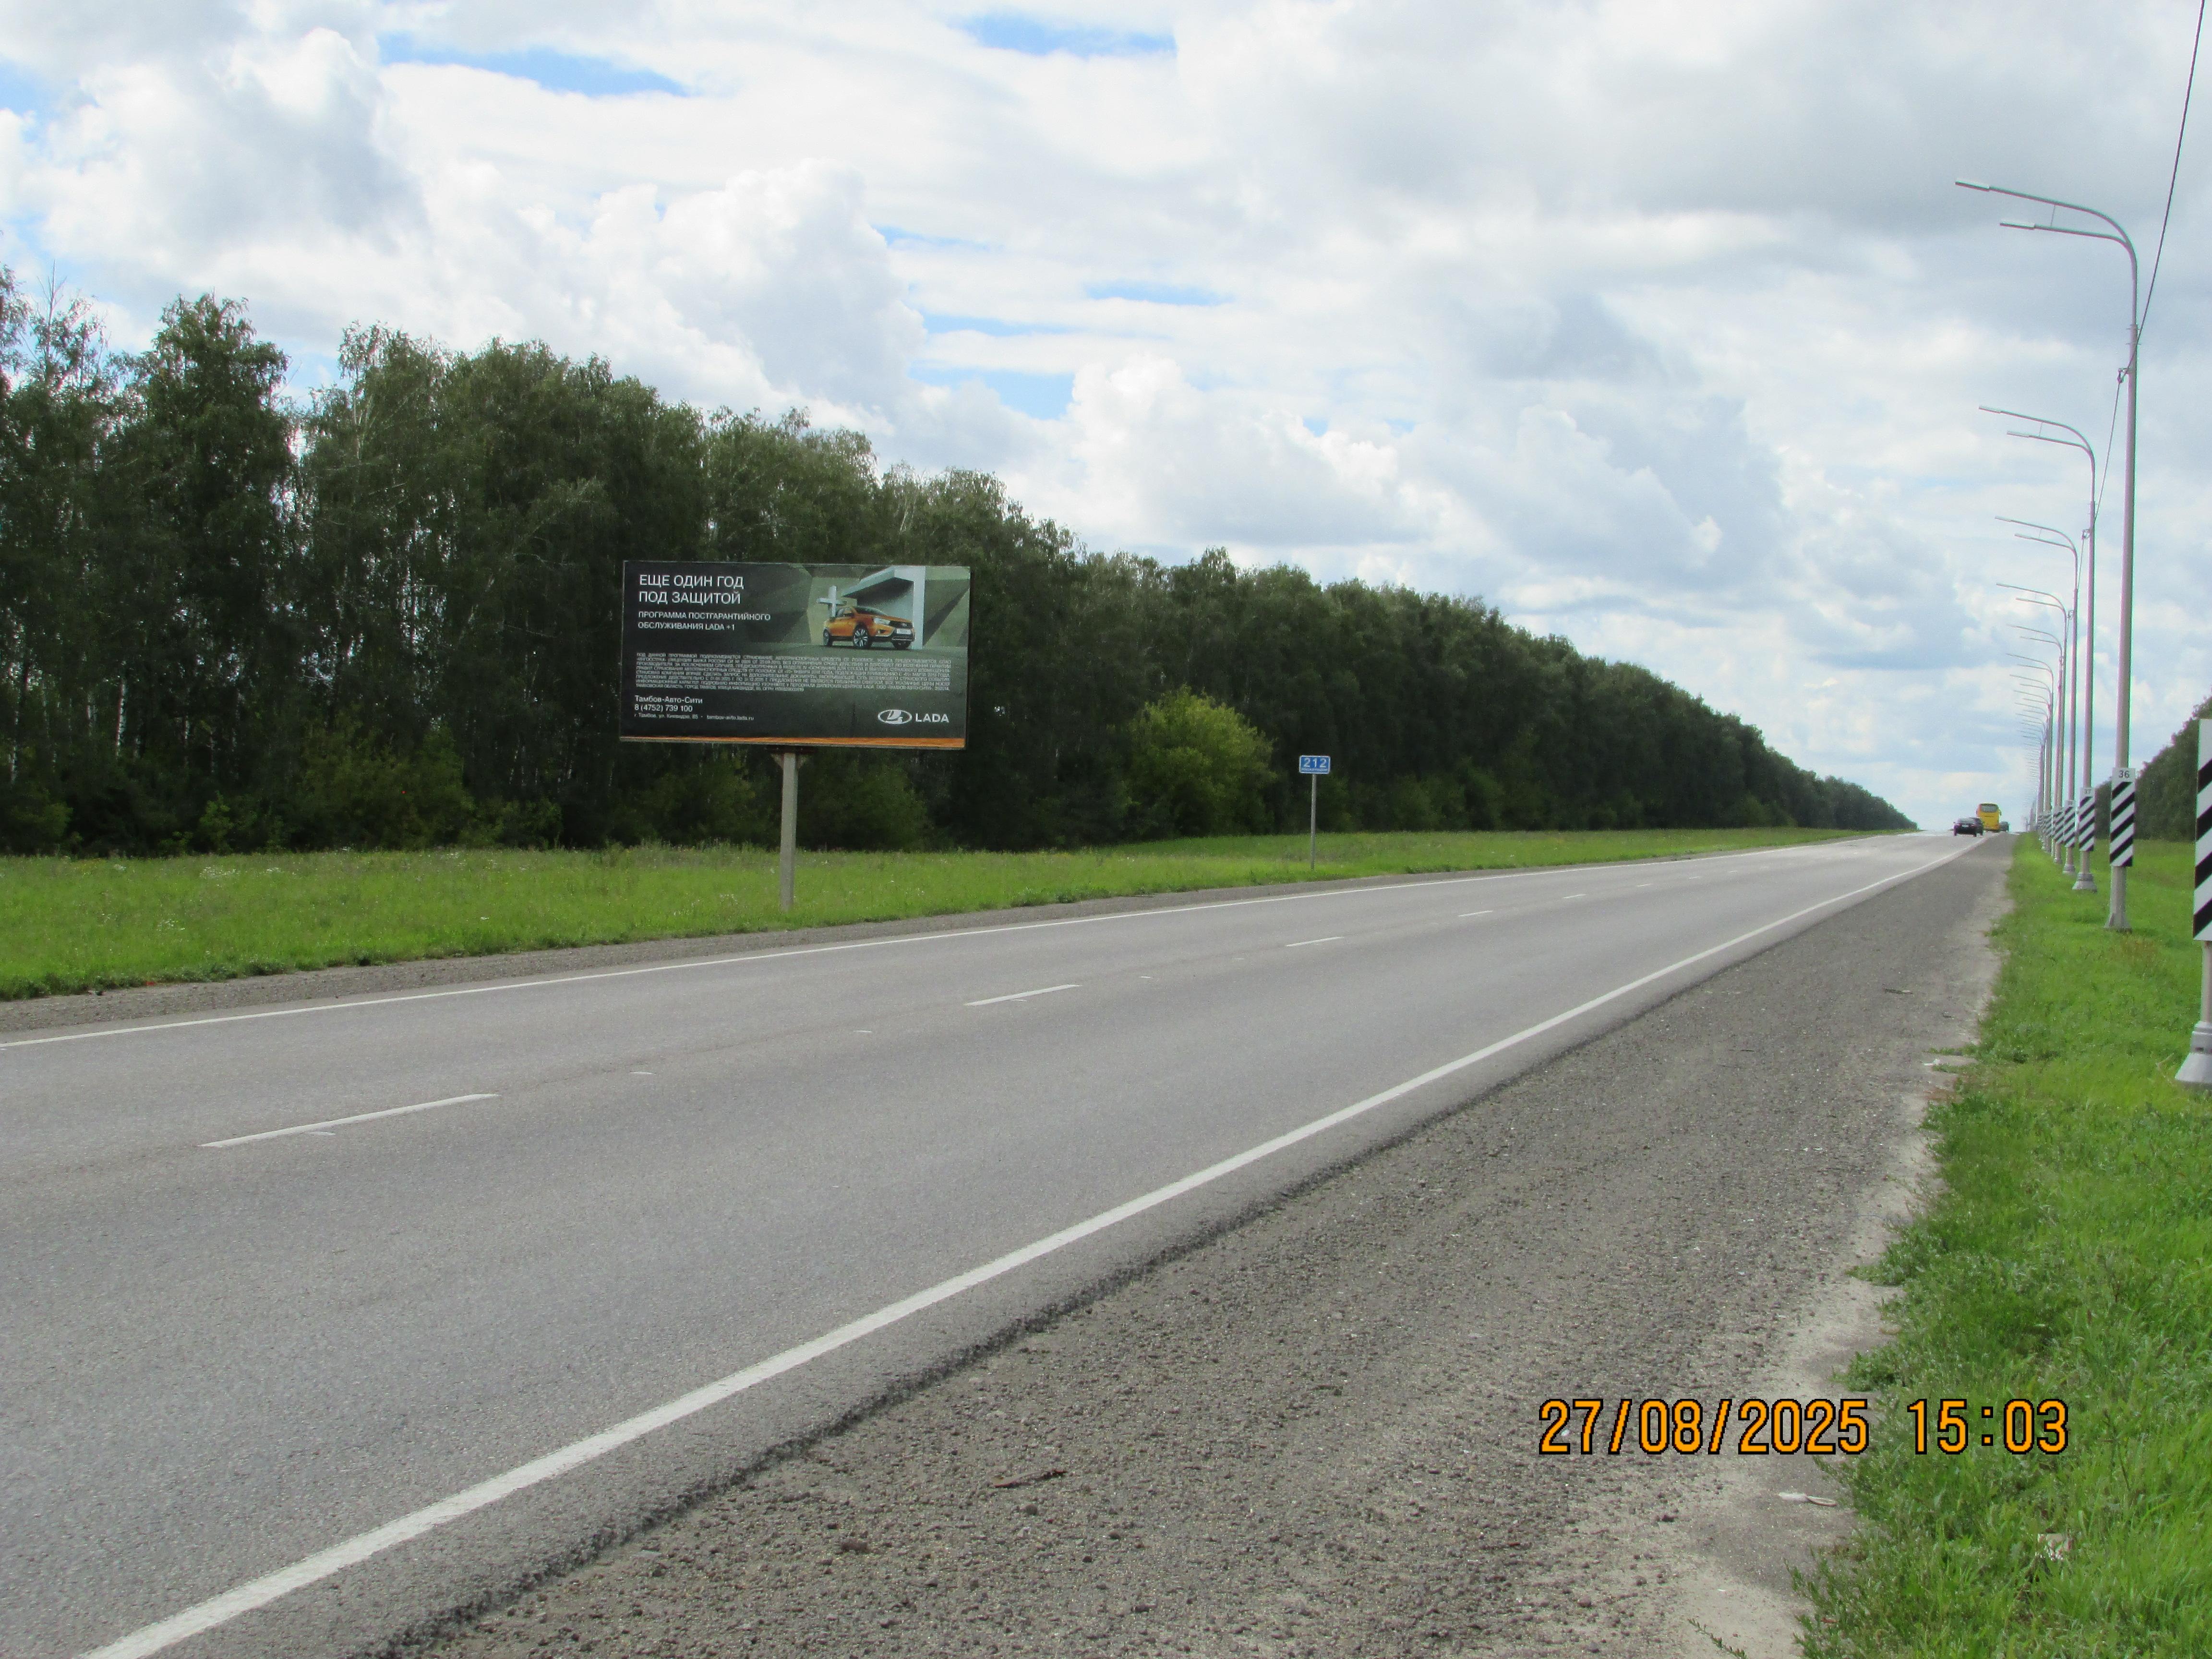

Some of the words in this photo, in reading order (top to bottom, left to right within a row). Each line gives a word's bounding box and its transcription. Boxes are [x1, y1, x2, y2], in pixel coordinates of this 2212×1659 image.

[640, 575, 671, 588] ЕЩЕ
[673, 575, 713, 589] ОДИН
[717, 576, 744, 589] ГОД
[639, 591, 668, 604] ПОД
[672, 591, 741, 605] ЗАЩИТОЙ
[688, 612, 771, 621] ПОСТГАРАНТИЙНОГО
[638, 622, 704, 630] ОБСЛУЖИВАНИЯ
[634, 695, 703, 704] Тамбов-Авто-Сити
[640, 704, 663, 712] (4752)
[915, 713, 950, 723] LADA
[1303, 757, 1326, 768] 212
[2118, 769, 2130, 778] 36
